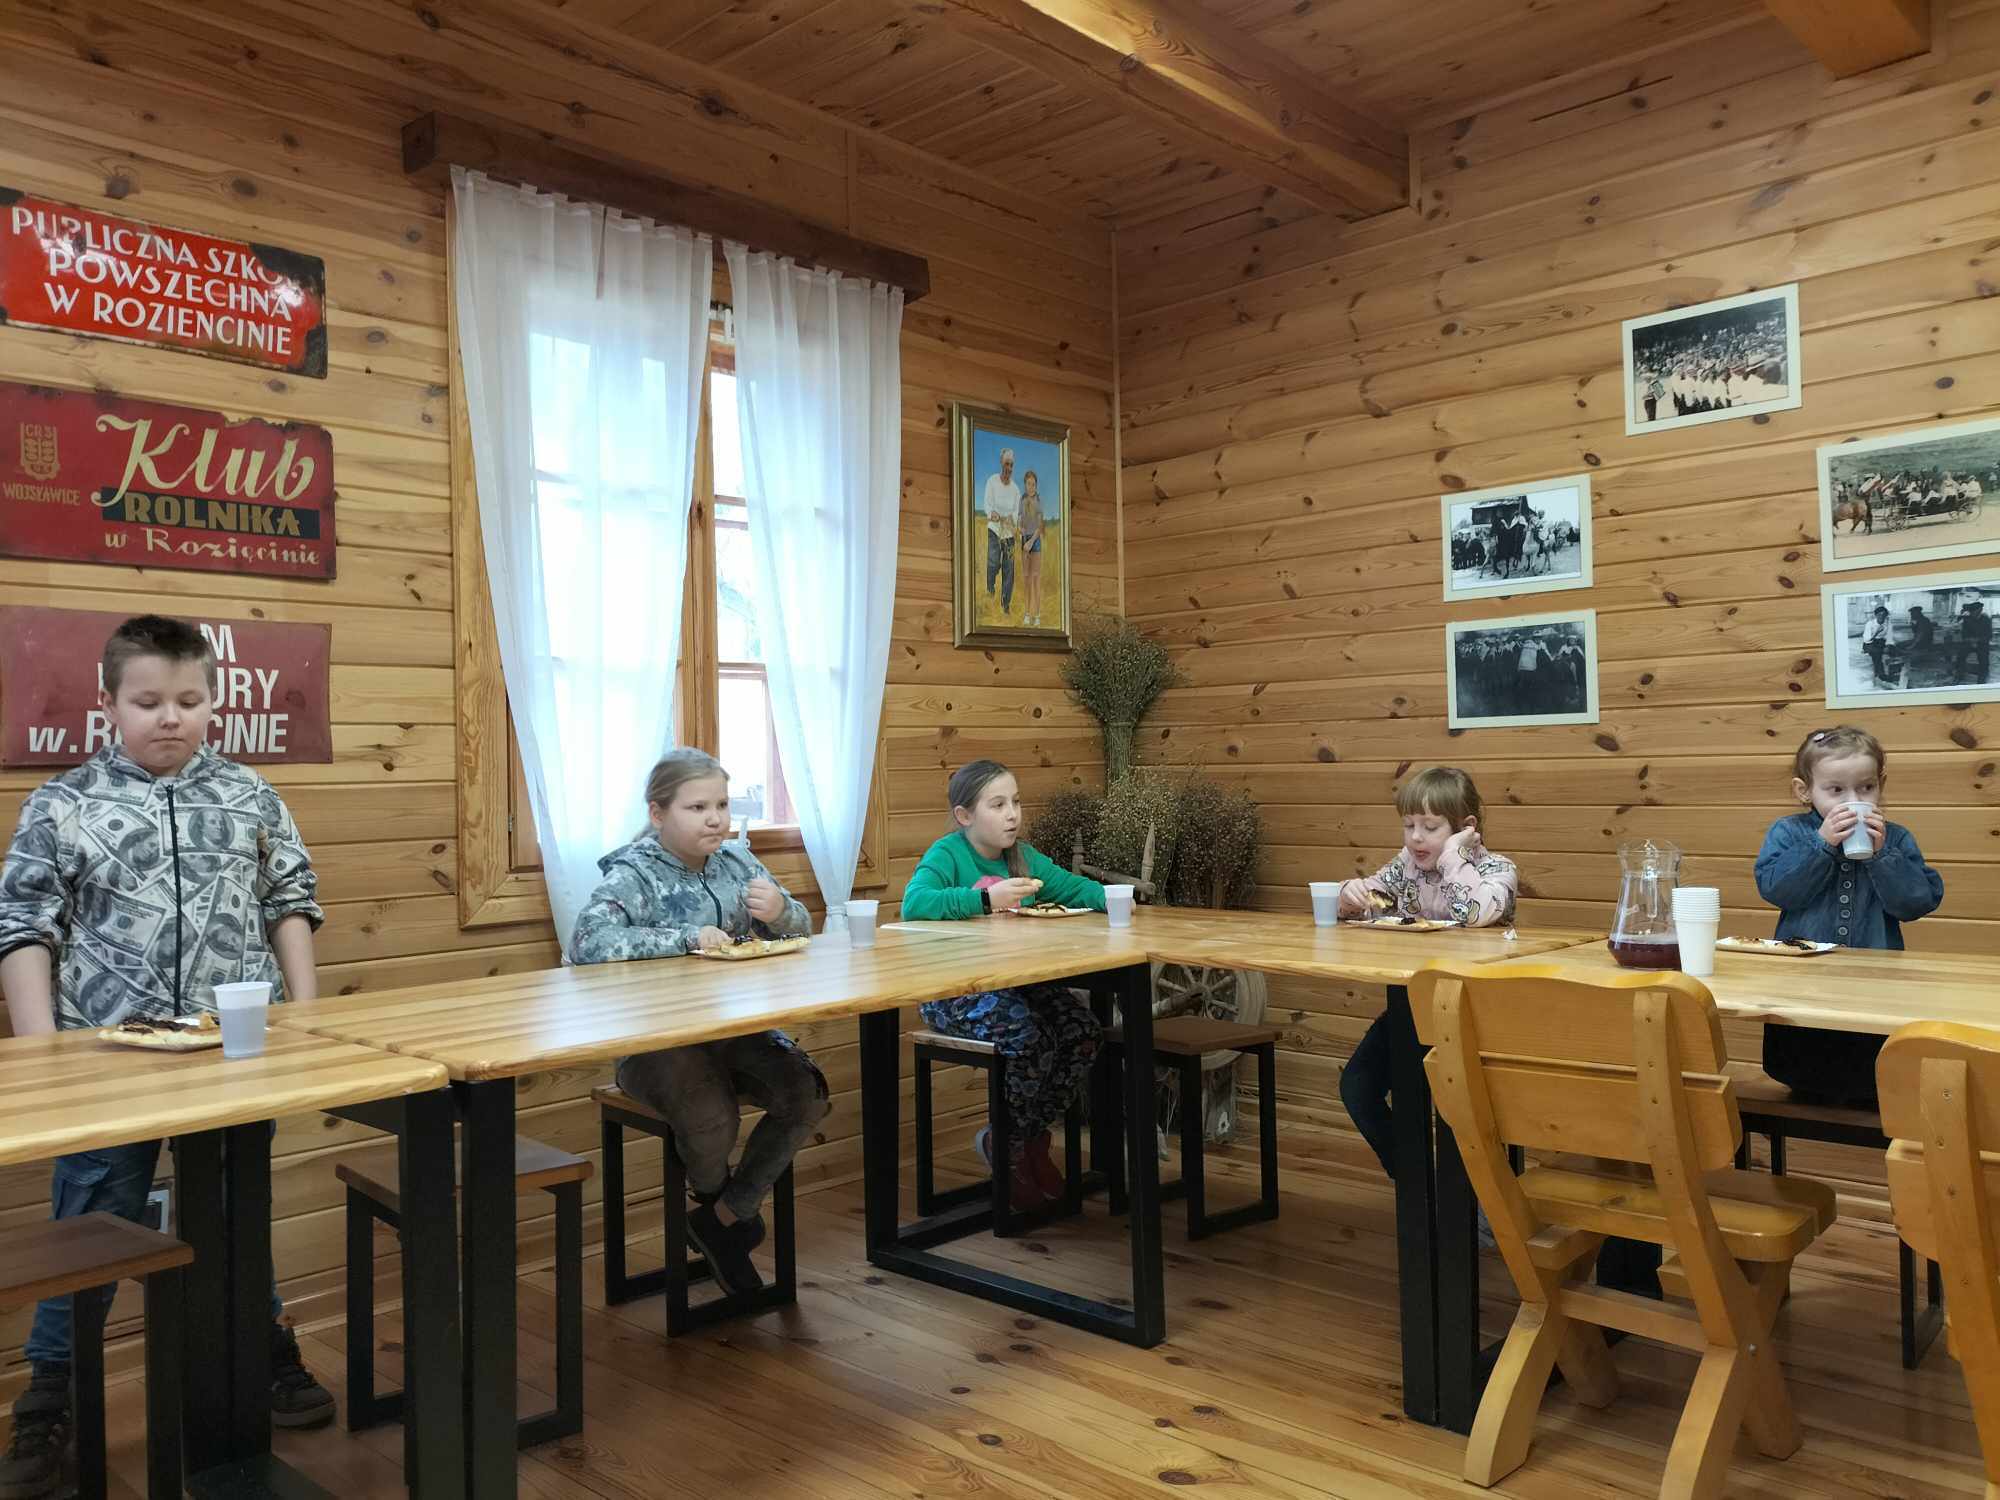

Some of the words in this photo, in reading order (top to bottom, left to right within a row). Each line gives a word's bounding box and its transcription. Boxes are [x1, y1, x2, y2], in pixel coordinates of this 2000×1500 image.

[44, 282, 79, 315] W
[93, 292, 291, 356] ROZIENCINIE
[49, 247, 293, 322] POWSZECHNA
[91, 414, 315, 508] Klub
[104, 532, 128, 549] w
[124, 491, 300, 537] ROLNIKA
